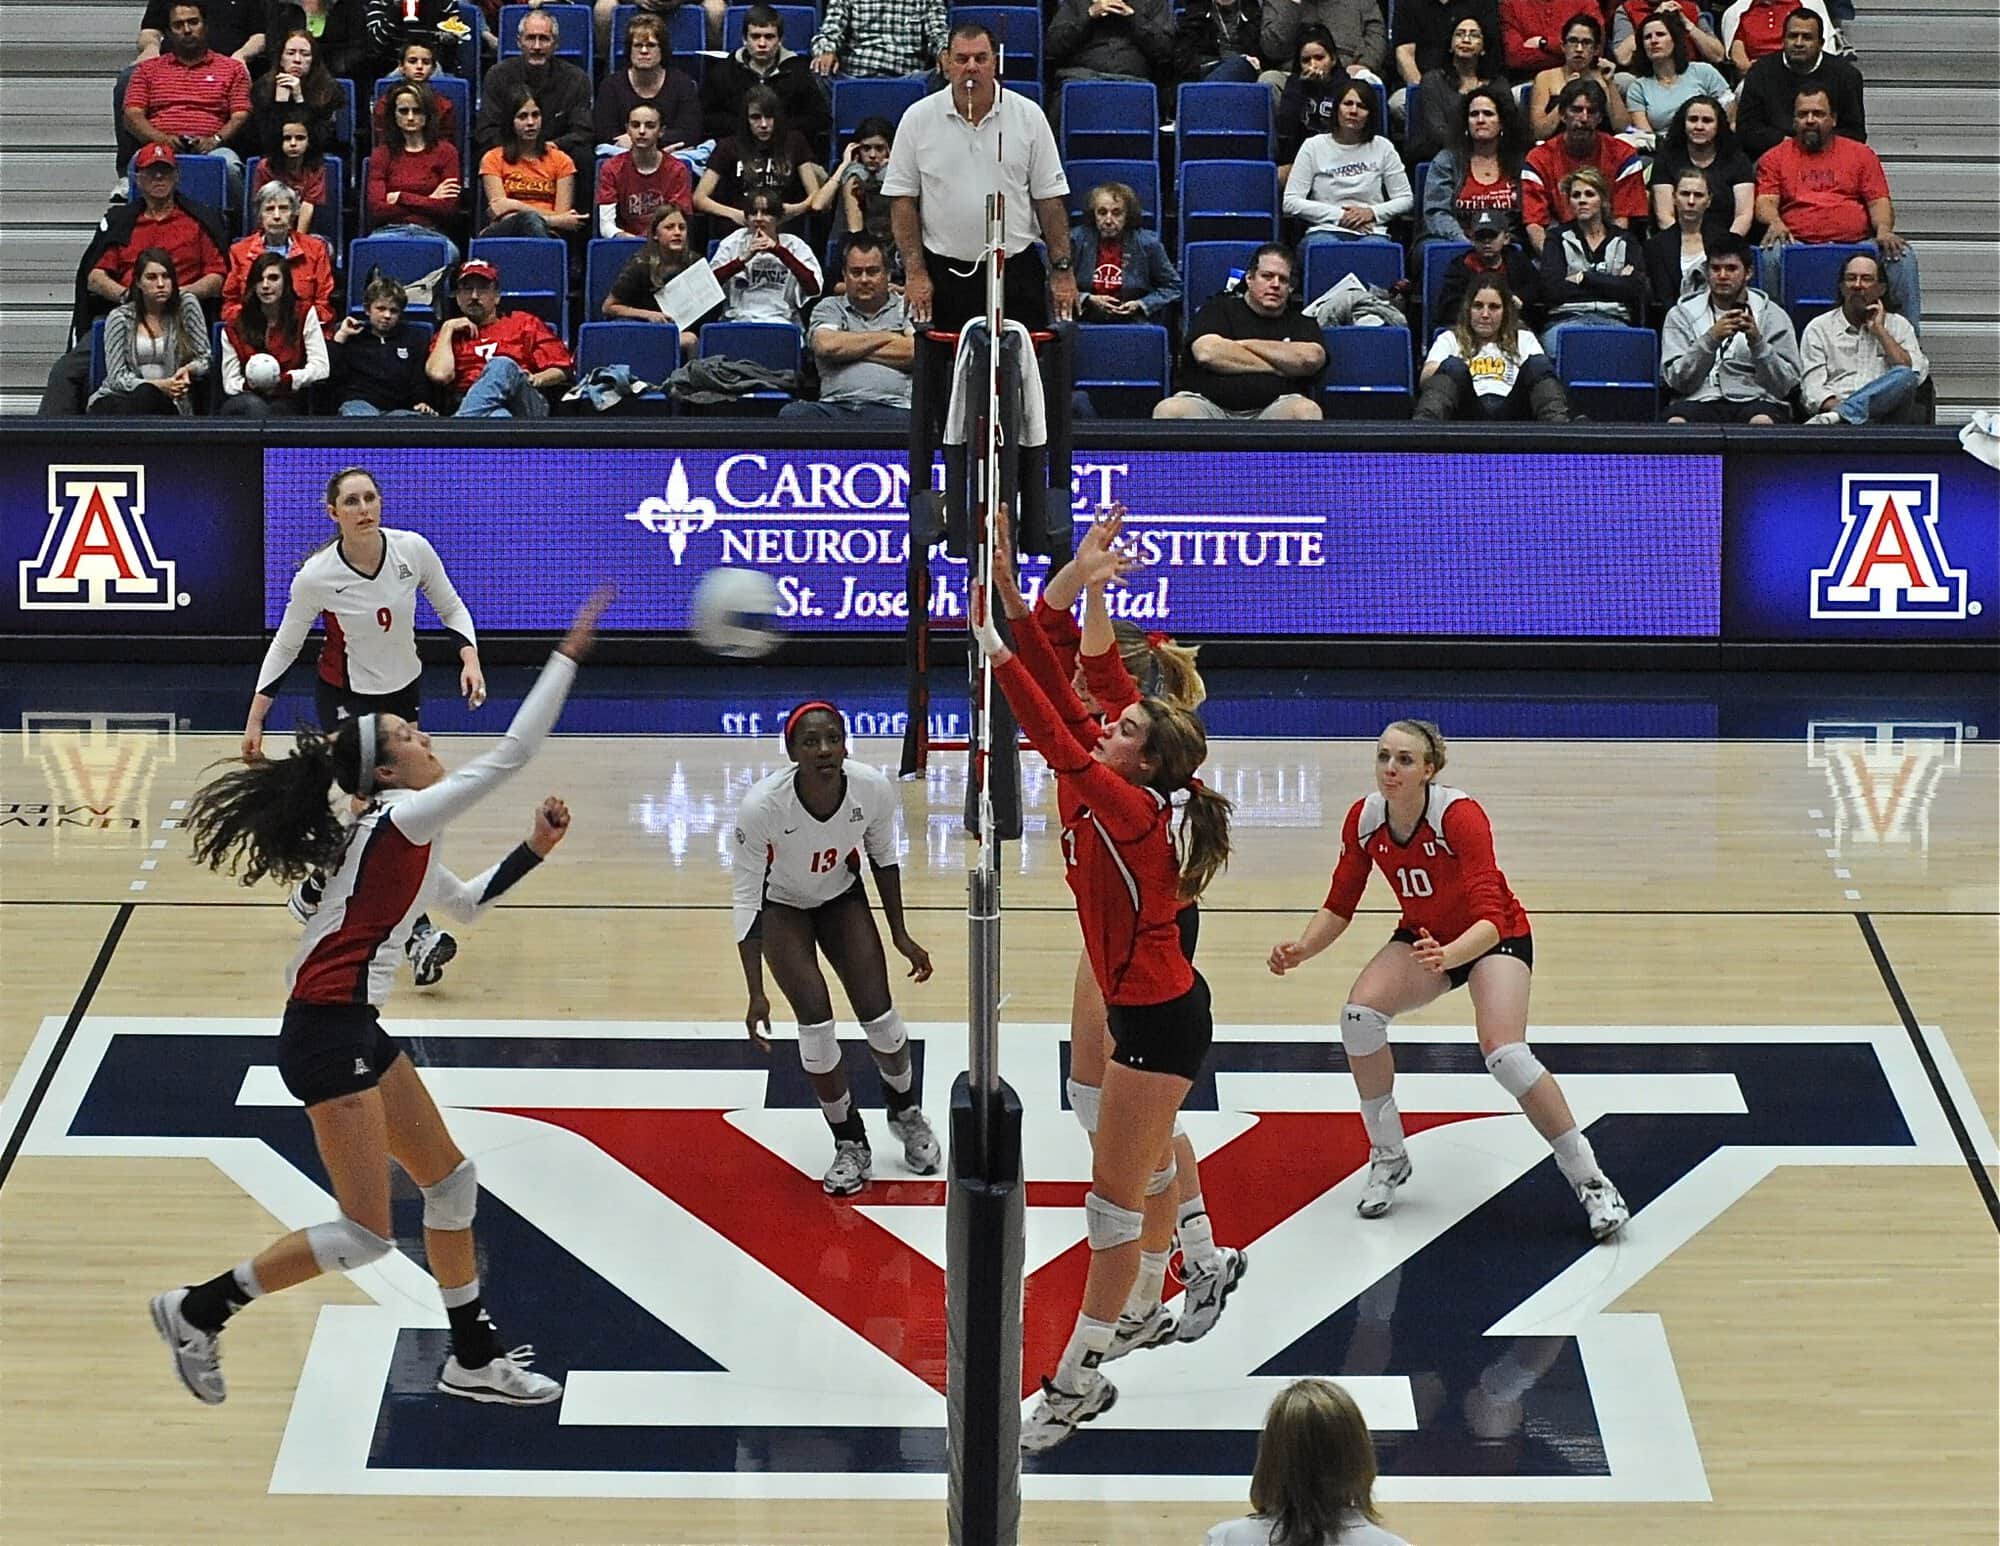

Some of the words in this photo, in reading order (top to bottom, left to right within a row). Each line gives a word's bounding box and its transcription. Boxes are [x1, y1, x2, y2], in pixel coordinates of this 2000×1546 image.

[19, 464, 176, 611] A
[1810, 473, 1968, 619] A
[376, 606, 392, 633] 9
[810, 847, 839, 874] 13
[1422, 842, 1437, 857] U
[1396, 867, 1434, 898] 10
